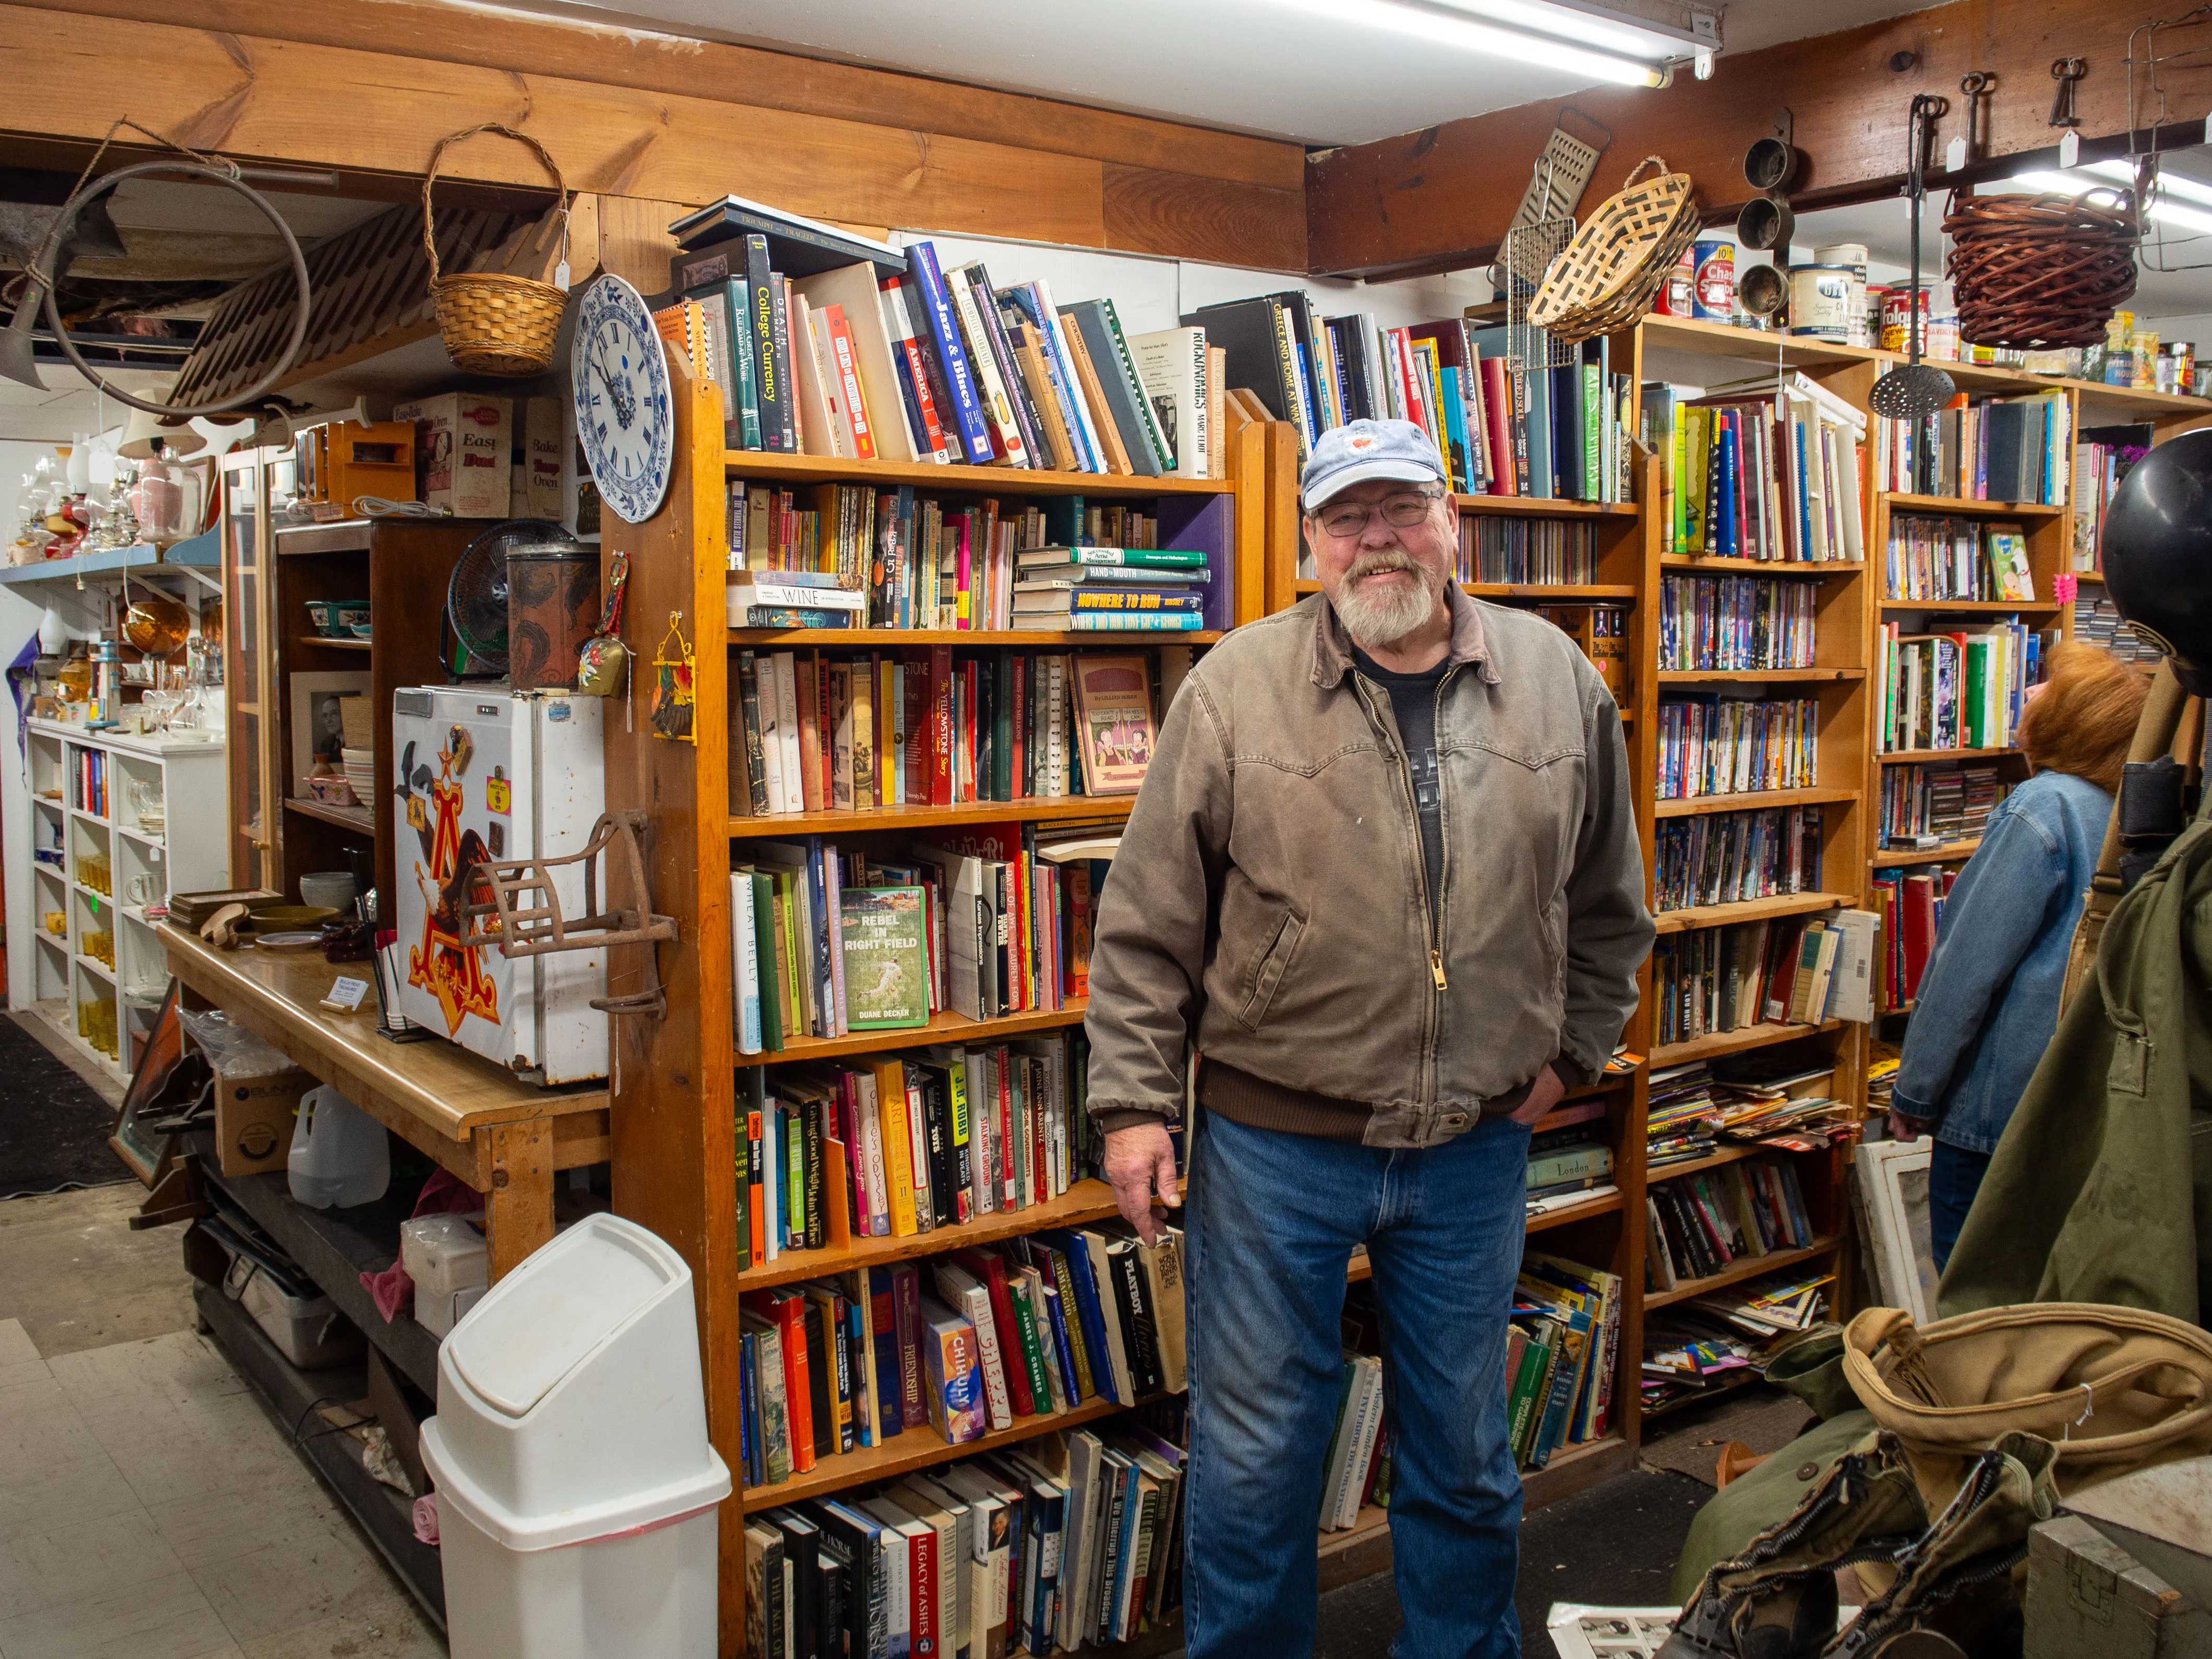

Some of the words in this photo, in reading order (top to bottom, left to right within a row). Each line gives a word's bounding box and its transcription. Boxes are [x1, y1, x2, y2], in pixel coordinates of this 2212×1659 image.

[758, 286, 770, 338] College
[776, 297, 787, 346] DEATH
[936, 299, 954, 342] Jazz
[1273, 303, 1283, 338] GREECE
[1035, 302, 1045, 334] PAPER
[1044, 332, 1056, 364] MAGIC
[1070, 320, 1087, 355] COUNTRY
[1884, 328, 1905, 336] NEW
[948, 343, 960, 357] &
[1279, 339, 1289, 360] AND
[762, 341, 775, 402] Currency
[909, 346, 929, 403] AMERICA
[952, 358, 972, 409] Blues
[1193, 332, 1206, 410] ROCKONOMICS
[1283, 361, 1294, 389] ROME
[1287, 390, 1296, 404] AT
[1301, 372, 1310, 400] SURVIVAL
[1291, 402, 1301, 425] WAR
[533, 439, 558, 453] Bake
[1197, 434, 1206, 453] ELIOT
[1461, 414, 1470, 460] COIN-OP
[534, 475, 558, 488] Oven
[733, 508, 742, 530] YANKEES
[732, 530, 741, 548] READER
[1087, 548, 1114, 557] Successful
[1089, 567, 1109, 578] HAND
[1113, 568, 1137, 579] MOUTH
[782, 588, 819, 605] WINE
[1077, 593, 1125, 608] NOWHERE
[1125, 594, 1139, 608] TO
[1139, 594, 1161, 609] RUN
[940, 679, 949, 693] The
[940, 694, 948, 755] YELLOWSTONE
[940, 756, 949, 777] Story
[746, 880, 755, 931] WHEAT
[1007, 895, 1015, 908] OF
[861, 915, 900, 927] REBEL
[874, 928, 887, 939] IN
[1007, 911, 1016, 931] AWE
[844, 939, 883, 951] RIGHT
[884, 937, 918, 949] FIELD
[747, 940, 757, 983] BELLY
[1009, 948, 1018, 987] LAUREN
[1011, 989, 1019, 1003] FOX
[859, 1010, 882, 1019] DUANE
[883, 1008, 910, 1017] DECKER
[808, 1105, 818, 1137] Giving
[790, 1126, 801, 1142] BILL
[931, 1126, 940, 1153] TOYS
[980, 1116, 989, 1153] STALKING
[791, 1144, 802, 1172] BRYSON
[809, 1137, 819, 1160] Good
[959, 1150, 965, 1159] IN
[808, 1160, 820, 1190] Weight
[982, 1153, 991, 1187] GROUND
[1557, 1160, 1590, 1176] London
[900, 1186, 907, 1197] II
[1158, 1251, 1176, 1264] WORLD
[1160, 1266, 1178, 1279] FATHERS
[1055, 1261, 1073, 1317] DIMAGGIO
[1022, 1310, 1033, 1342] JAMES
[1029, 1345, 1035, 1354] J.
[903, 1344, 918, 1403] FRIENDSHIP
[952, 1336, 970, 1405] CHIHULY
[1030, 1355, 1043, 1394] CRAMER
[1371, 1388, 1383, 1423] Western
[1520, 1397, 1532, 1428] COMPLETE
[1365, 1425, 1376, 1456] Garden
[1513, 1428, 1523, 1453] GUIDE
[1357, 1459, 1367, 1483] Book
[1112, 1500, 1123, 1515] We
[826, 1535, 852, 1557] HORSE
[1108, 1516, 1121, 1557] Interrupt
[872, 1565, 879, 1576] OF
[917, 1537, 929, 1585] LEGACY
[999, 1554, 1008, 1578] John
[1105, 1557, 1115, 1578] This
[772, 1576, 782, 1603] THE
[918, 1585, 928, 1597] of
[997, 1583, 1007, 1616] Adams
[1100, 1579, 1114, 1626] Broadcast
[772, 1609, 783, 1638] AGE
[869, 1597, 882, 1657] HORSE
[918, 1597, 929, 1636] ASHES
[772, 1640, 783, 1657] OF
